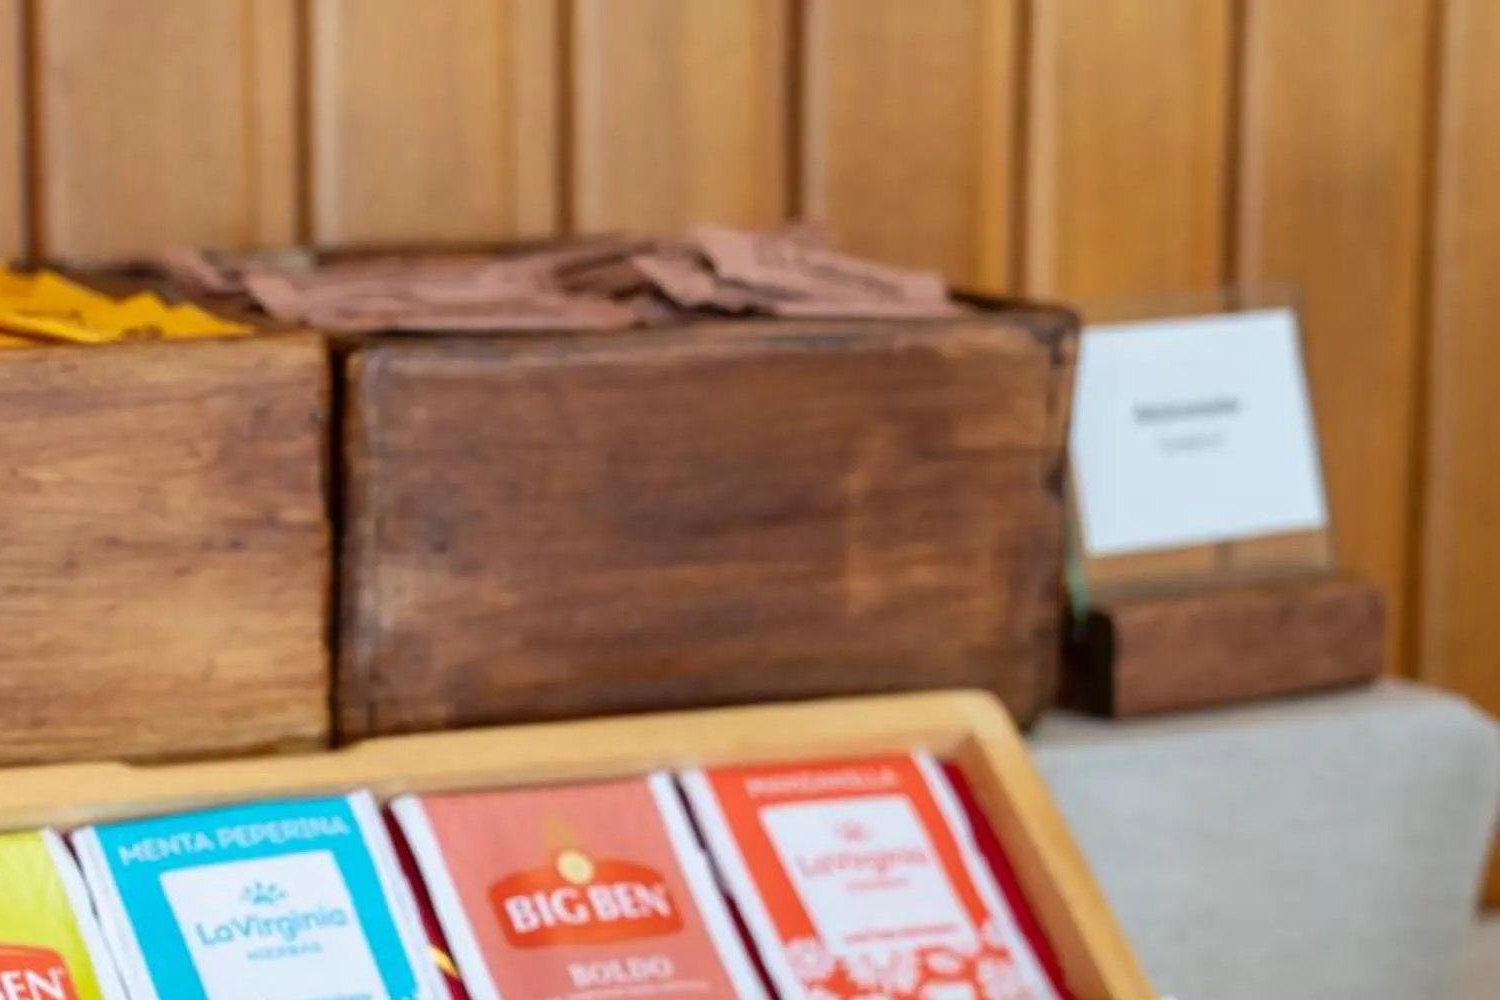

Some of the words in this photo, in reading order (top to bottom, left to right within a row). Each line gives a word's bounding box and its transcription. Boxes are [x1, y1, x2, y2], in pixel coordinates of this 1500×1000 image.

[118, 831, 213, 865] MENTA
[215, 816, 350, 848] PEPERINA
[504, 888, 588, 934] BIG
[588, 882, 671, 918] BEN
[567, 957, 673, 988] BOLDO
